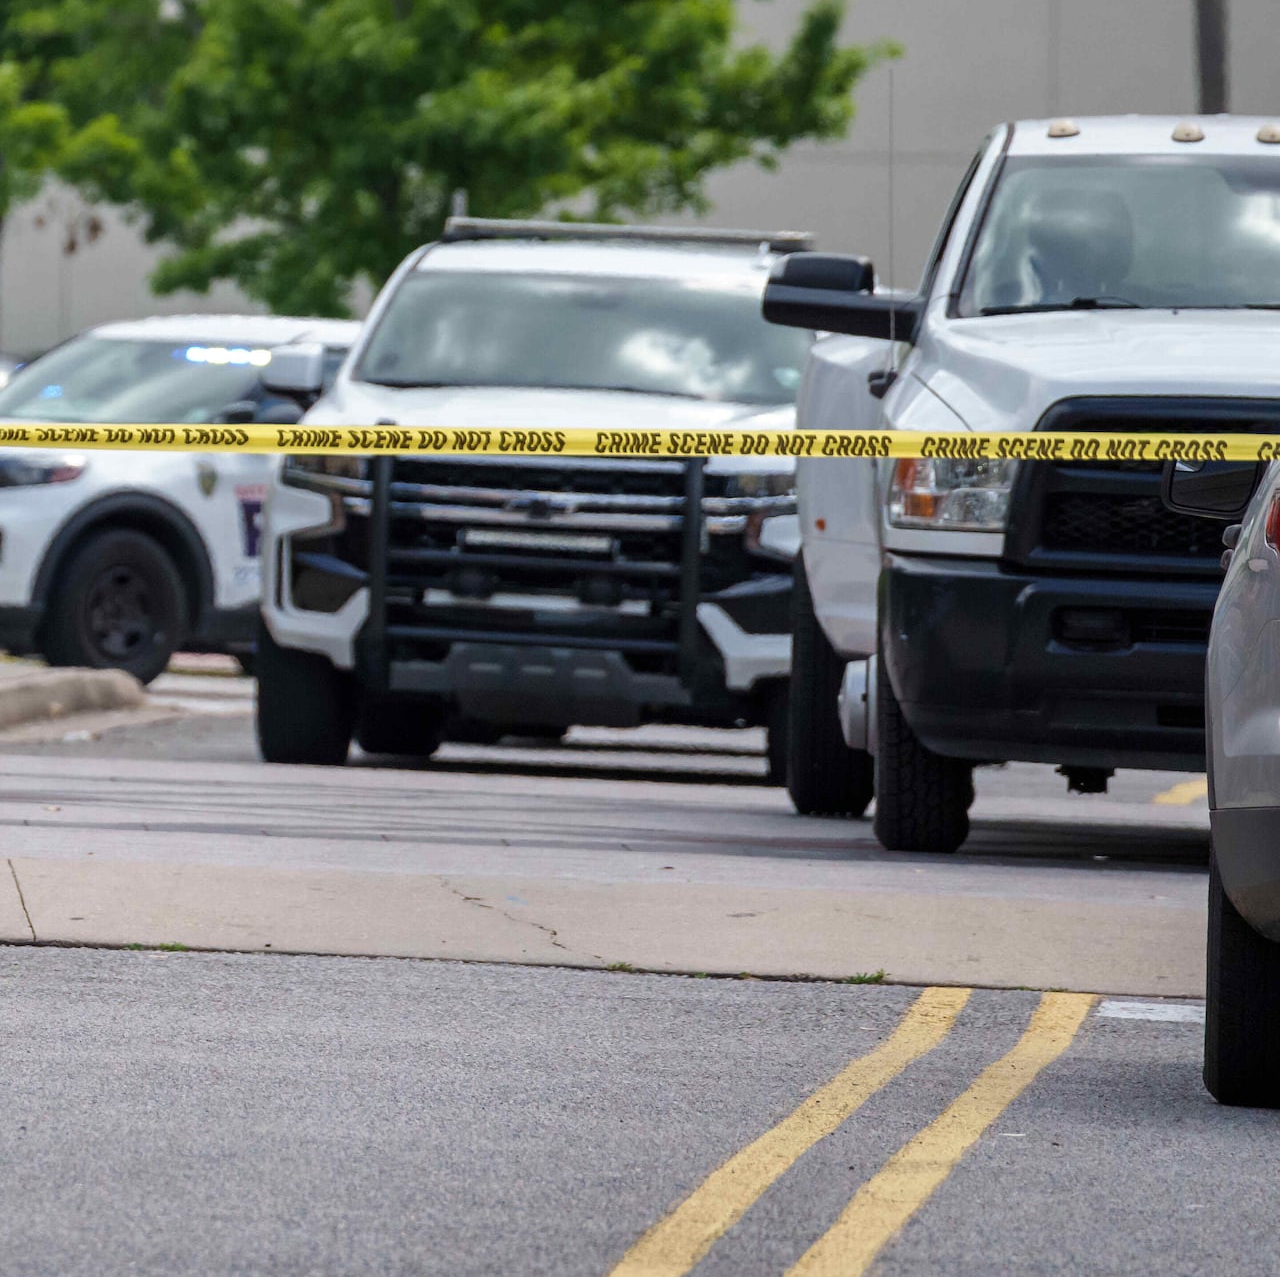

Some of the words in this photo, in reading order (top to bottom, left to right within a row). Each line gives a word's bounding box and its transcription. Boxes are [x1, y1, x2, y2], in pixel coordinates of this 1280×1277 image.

[277, 430, 342, 447] CRIME
[348, 430, 413, 449] SCENE
[418, 431, 447, 450] DO
[452, 431, 492, 451] NOT
[498, 431, 566, 452] CROSS
[595, 432, 662, 454] CRIME
[667, 433, 734, 455] SCENE
[740, 433, 770, 455] DO
[774, 434, 817, 456] NOT
[822, 435, 892, 457] CROSS
[920, 437, 990, 459] CRIME
[995, 438, 1065, 460] SCENE
[1070, 439, 1100, 460] DO
[1106, 439, 1151, 460] NOT
[1154, 440, 1227, 461] CROSS
